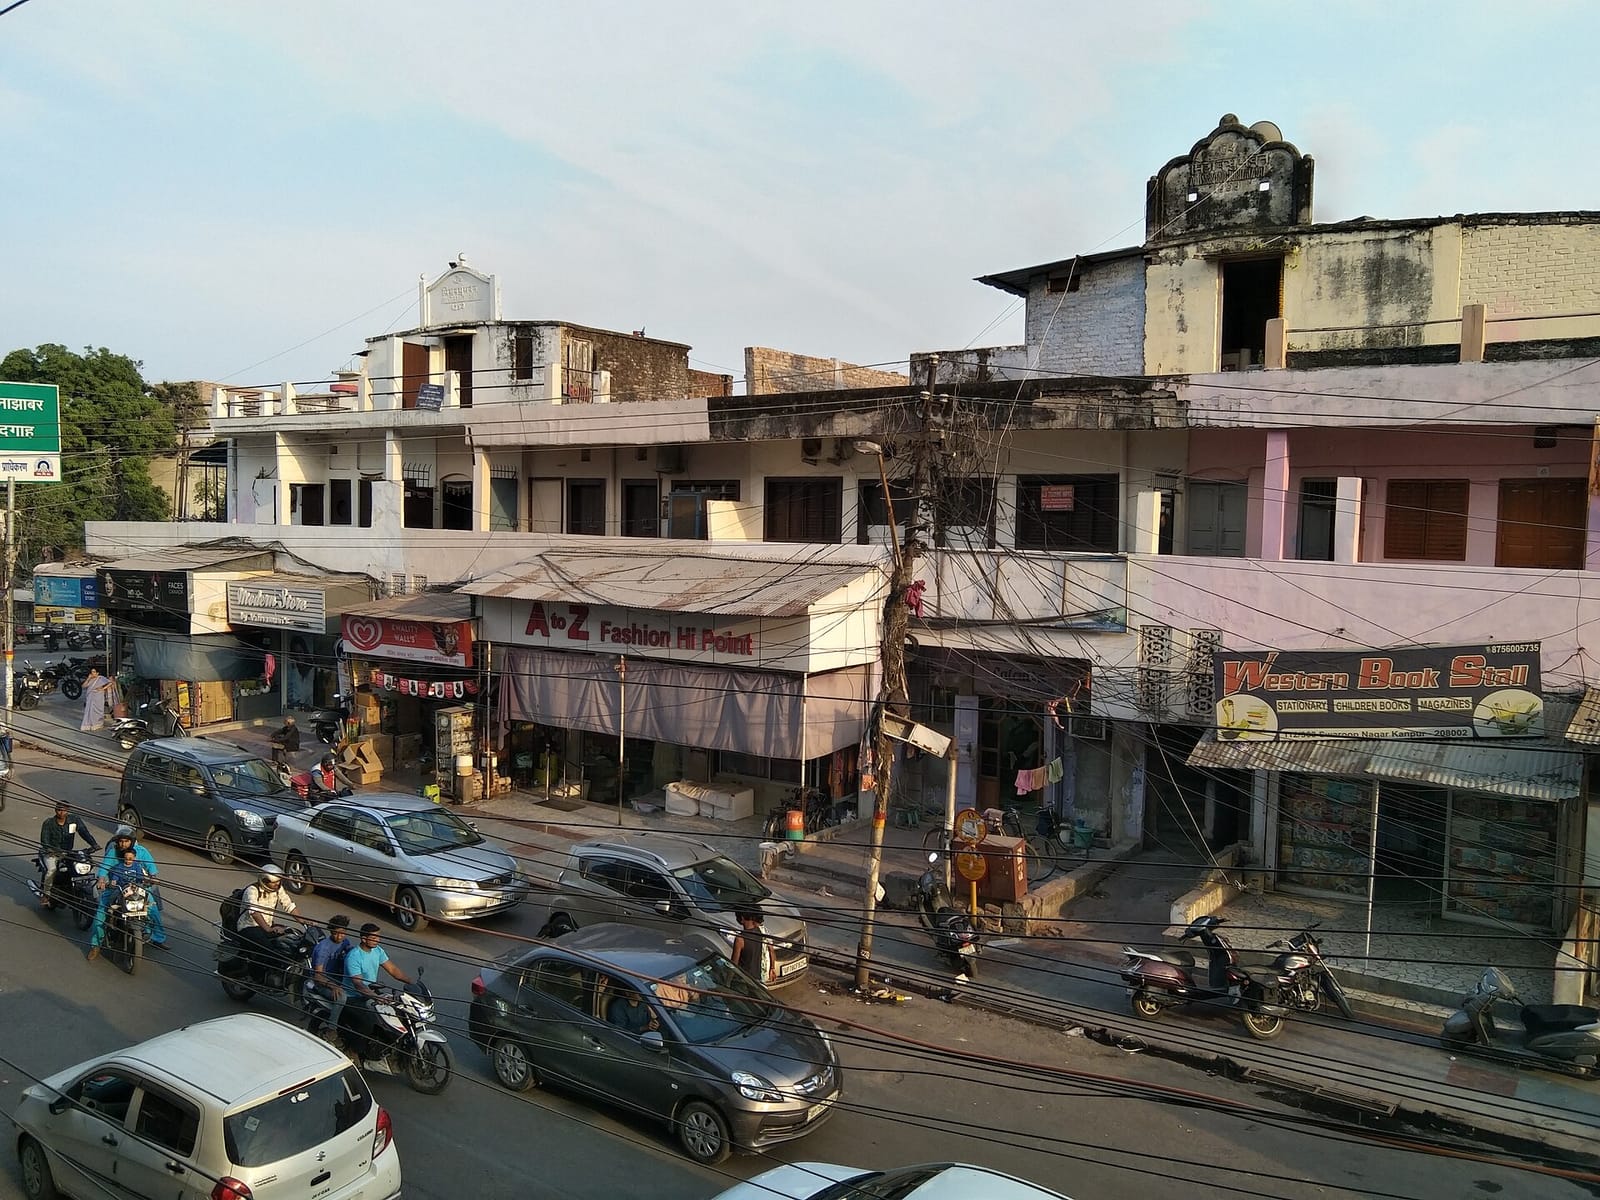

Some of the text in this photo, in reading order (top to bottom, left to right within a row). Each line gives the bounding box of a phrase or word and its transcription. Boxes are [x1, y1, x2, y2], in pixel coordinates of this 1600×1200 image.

[168, 581, 184, 590] FACES
[278, 588, 308, 612] Store
[391, 623, 419, 634] KWALITY
[600, 620, 671, 648] Fashion
[676, 626, 697, 650] Hi
[701, 628, 753, 656] Point
[1491, 644, 1539, 654] 8756005735
[1223, 651, 1530, 696] Western Book Stall
[1277, 701, 1327, 711] STATIONARY
[1335, 700, 1410, 711] CHILDREN BOOKS
[1420, 699, 1471, 710] MAGAZINES
[1362, 730, 1389, 739] Nagar
[1391, 730, 1425, 739] Kanpur
[1434, 729, 1468, 737] 208002
